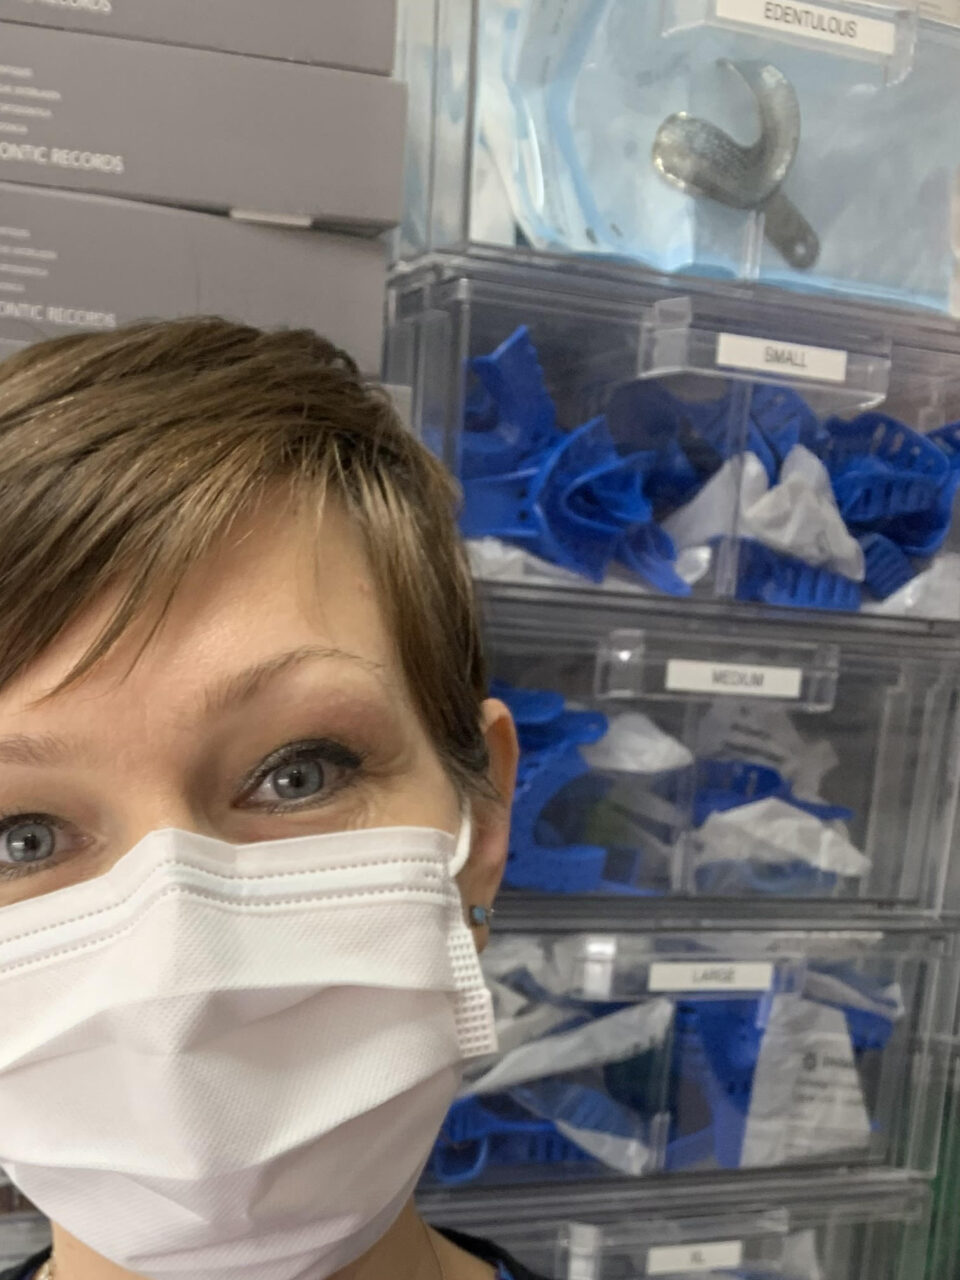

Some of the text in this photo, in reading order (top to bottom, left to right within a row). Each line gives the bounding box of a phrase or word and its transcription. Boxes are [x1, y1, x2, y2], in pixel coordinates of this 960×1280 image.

[764, 2, 858, 38] EDENTULOUS
[51, 148, 124, 174] RECORDS
[47, 306, 117, 328] RECORDS
[765, 346, 807, 368] SMALL
[712, 669, 765, 687] MEDIUM
[693, 967, 735, 984] LARGE
